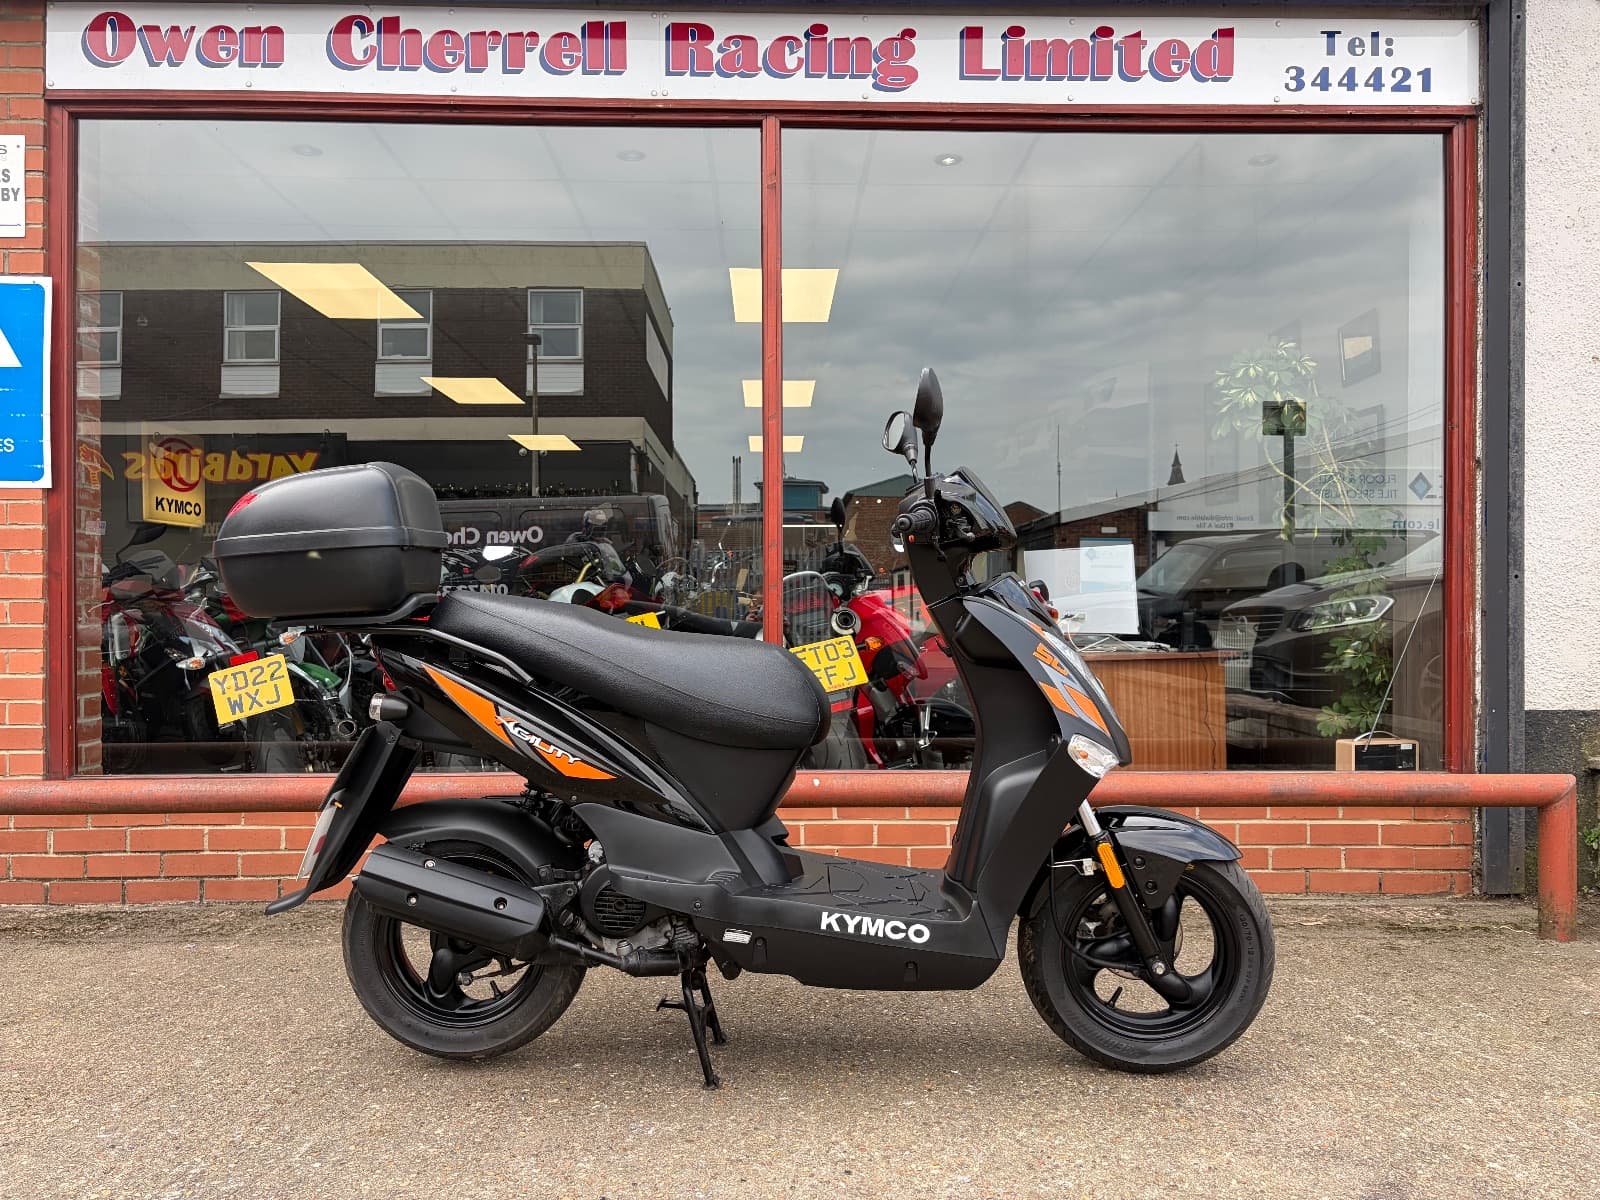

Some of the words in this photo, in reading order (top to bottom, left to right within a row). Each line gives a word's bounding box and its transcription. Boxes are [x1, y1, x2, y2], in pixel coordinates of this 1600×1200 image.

[81, 11, 285, 69] Owen
[326, 14, 627, 76] Cherrell
[665, 22, 917, 91] Racing
[959, 25, 1236, 82] Limited
[1320, 30, 1395, 56] Tel:
[1284, 65, 1433, 92] 344421
[0, 169, 11, 184] S
[154, 495, 202, 517] KYMCO
[213, 660, 285, 695] YD22
[226, 683, 281, 716] WXJ
[820, 911, 931, 945] KYMCO
